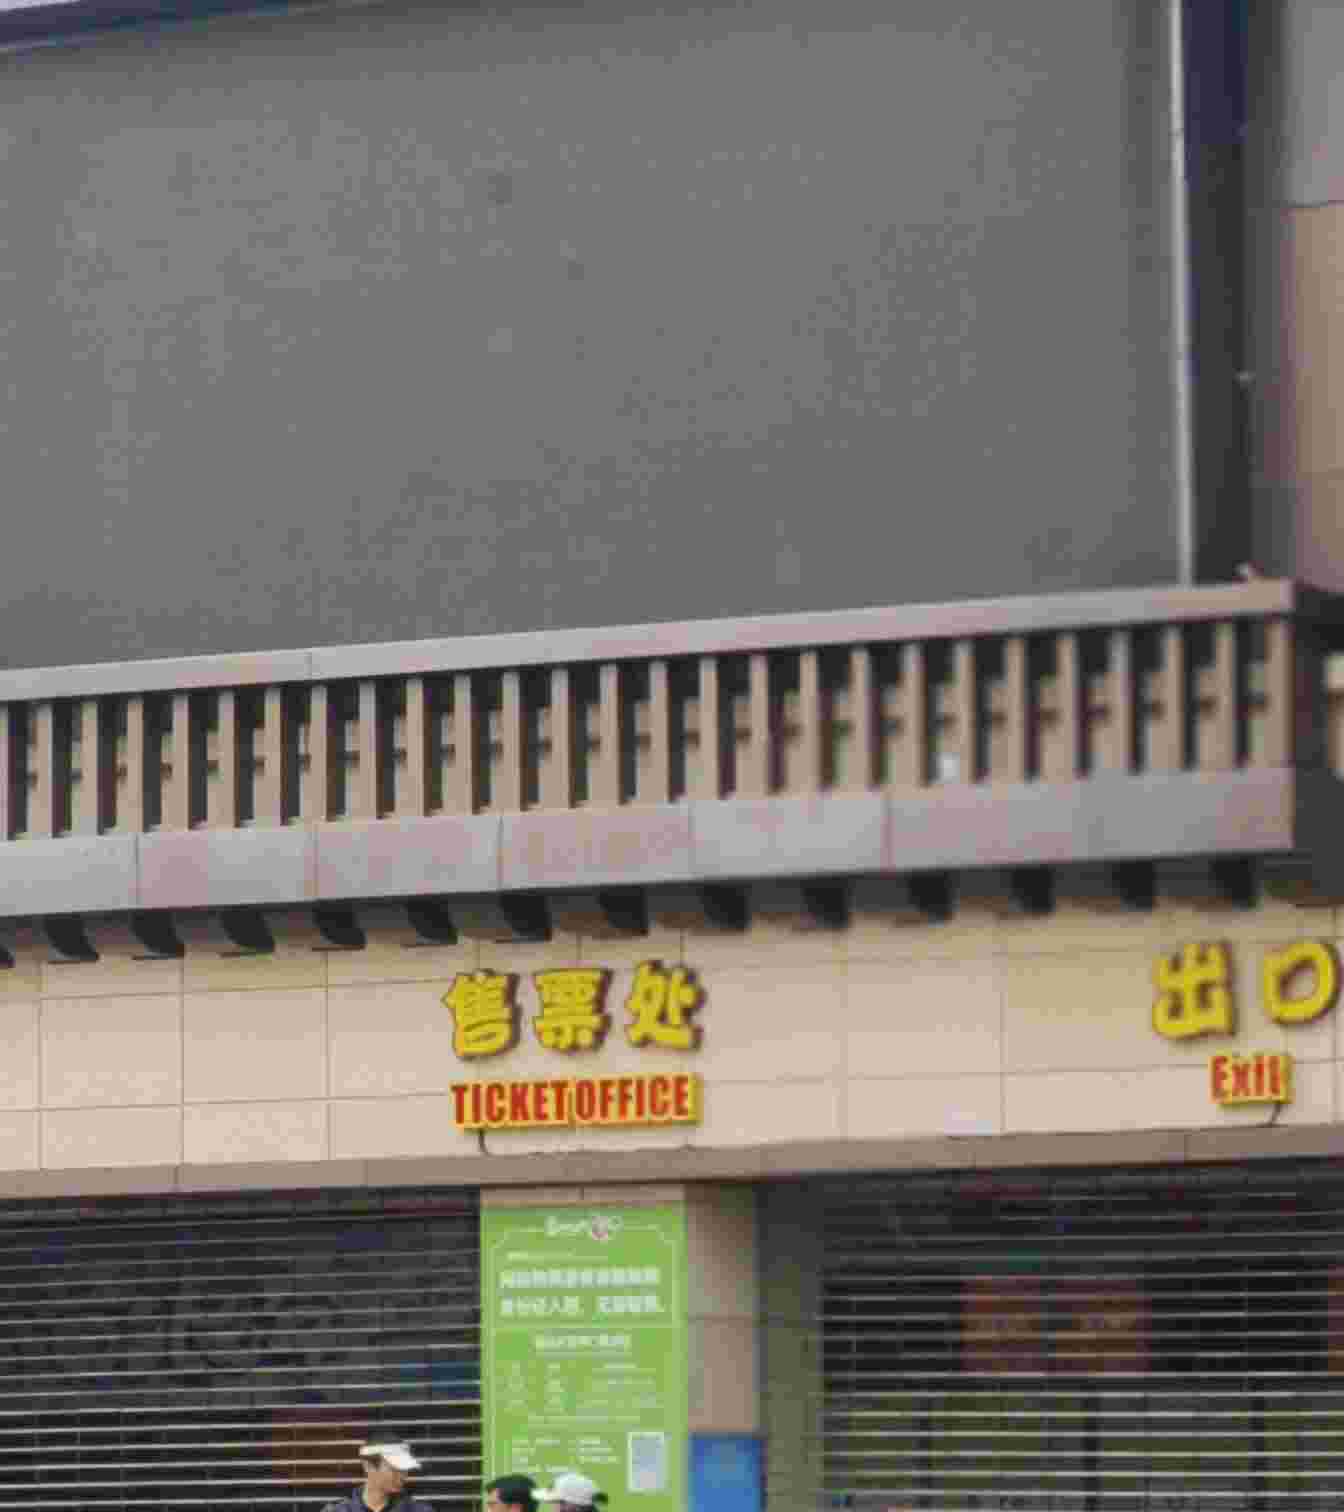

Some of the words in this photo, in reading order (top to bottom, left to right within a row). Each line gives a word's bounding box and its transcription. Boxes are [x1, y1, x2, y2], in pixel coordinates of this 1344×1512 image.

[441, 959, 709, 1059] 售票处
[1151, 938, 1344, 1039] 出口
[450, 1080, 569, 1124] TICKET
[574, 1075, 691, 1122] OFFICE
